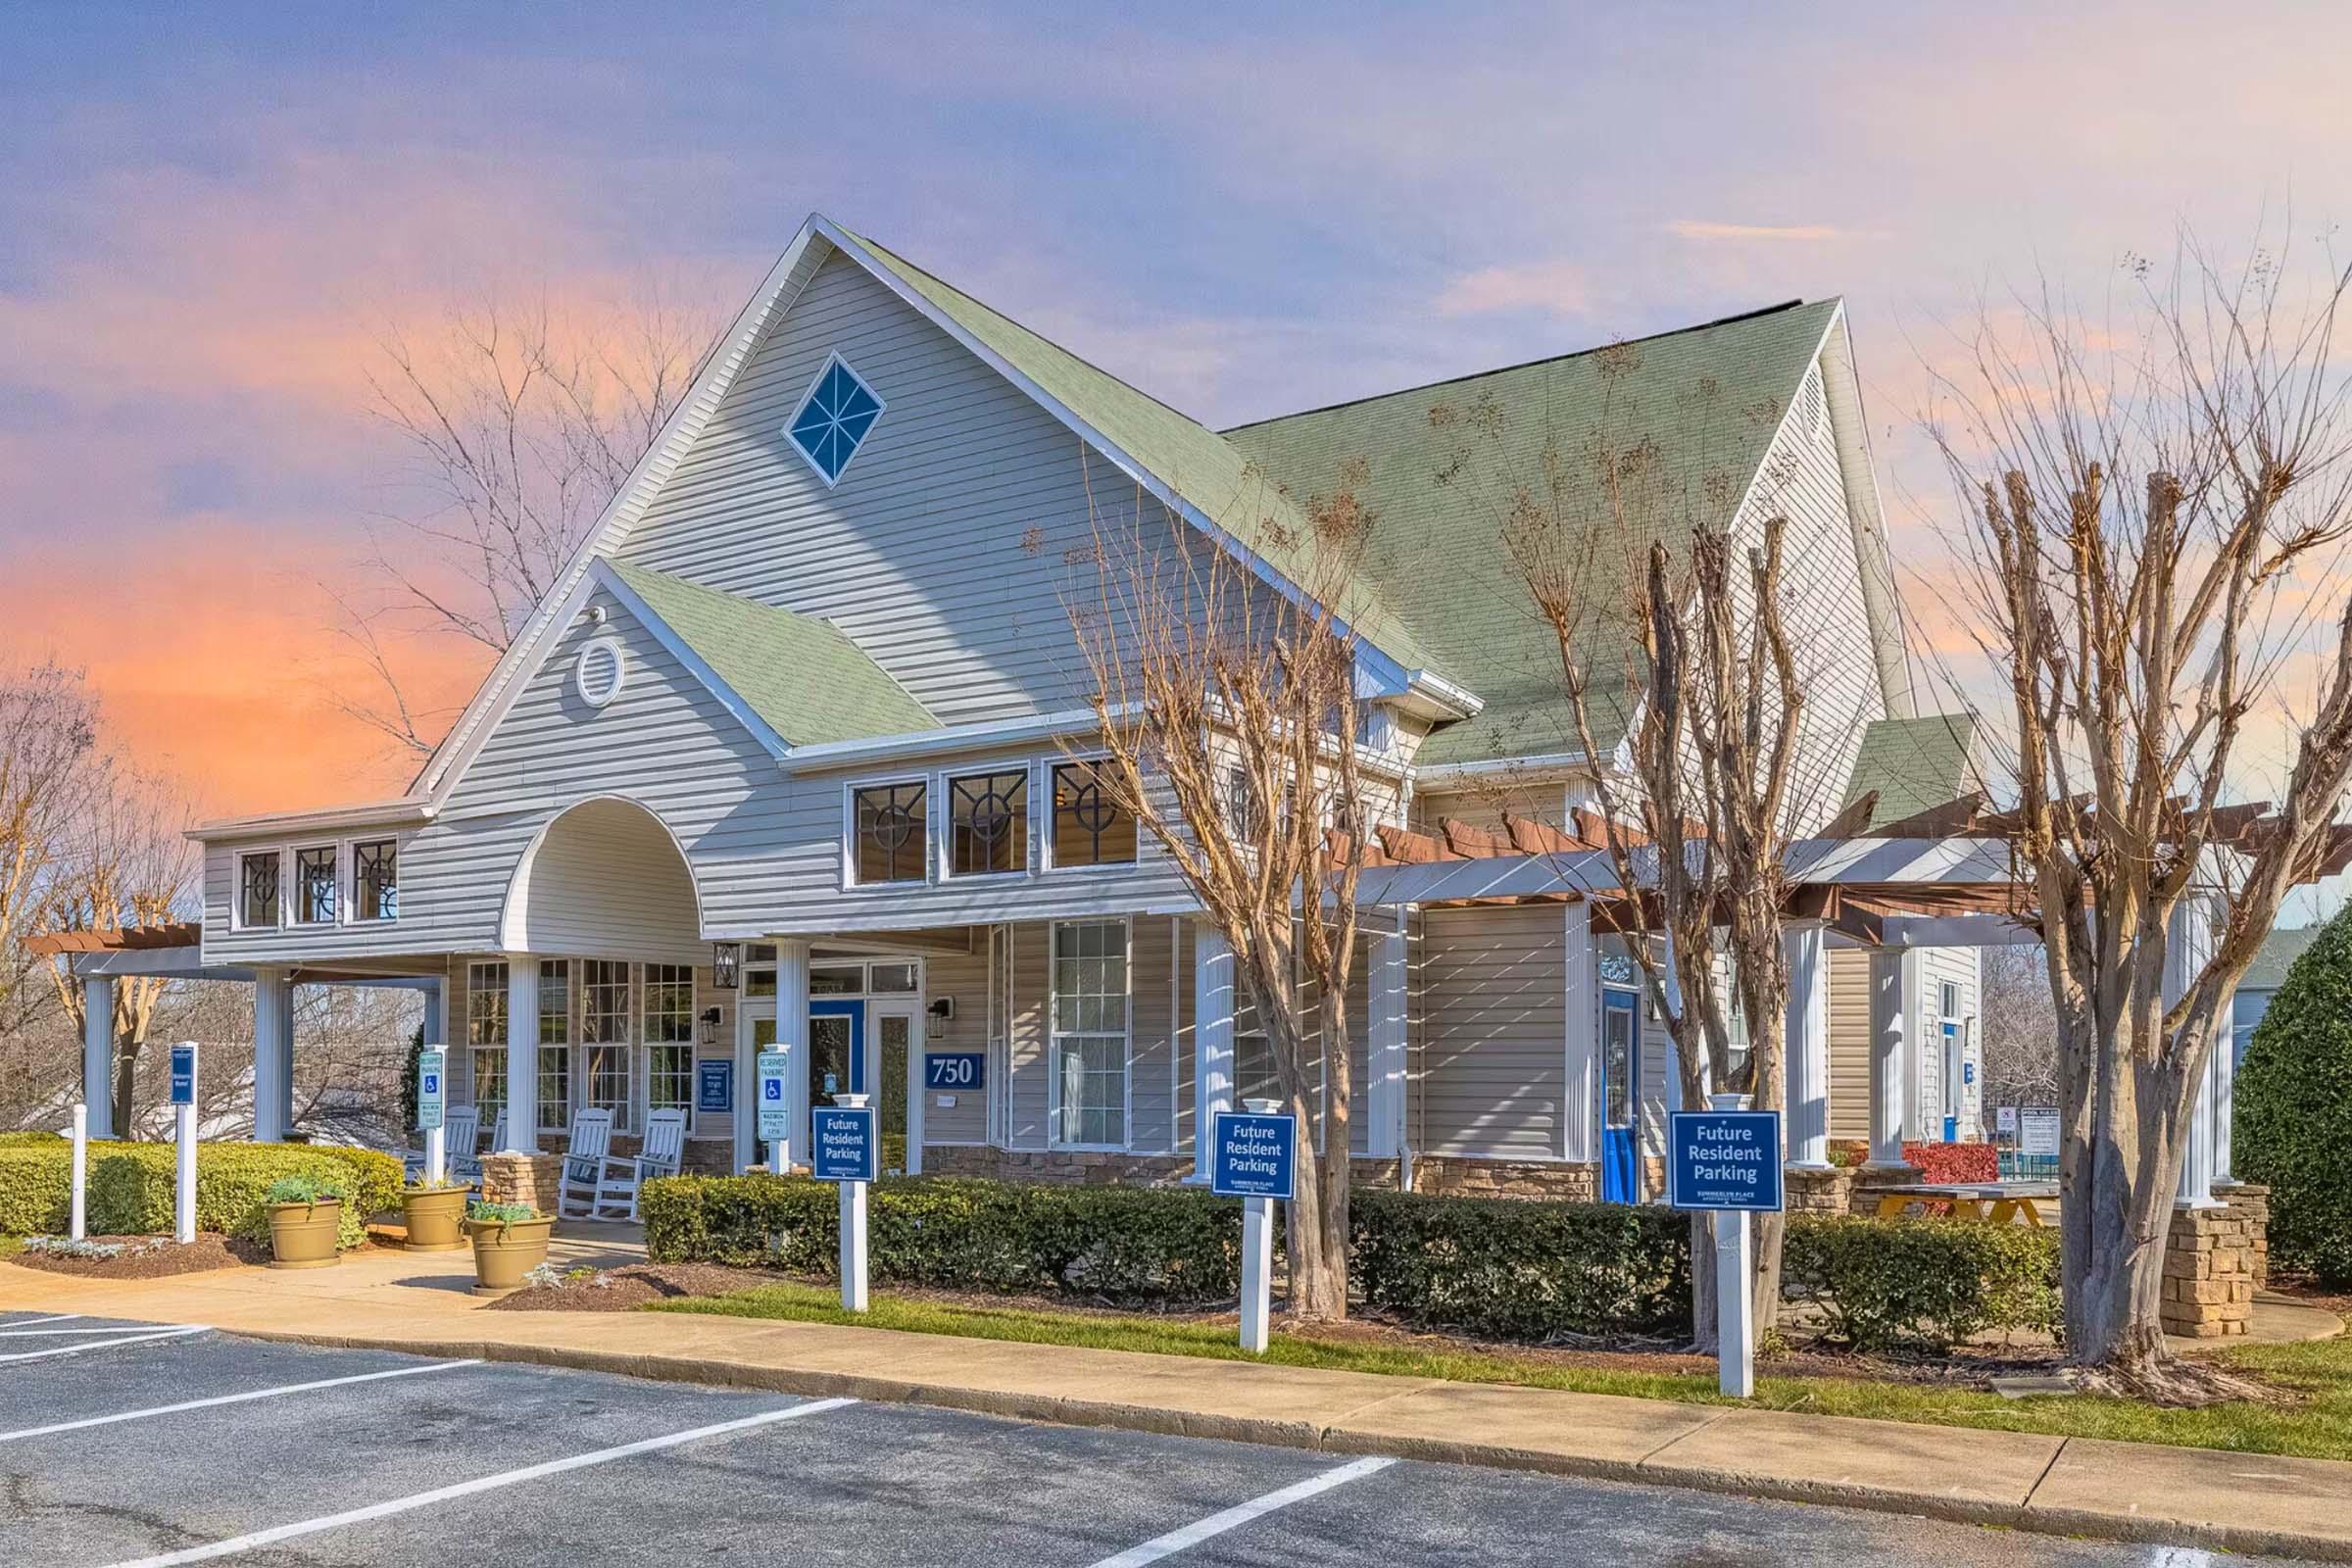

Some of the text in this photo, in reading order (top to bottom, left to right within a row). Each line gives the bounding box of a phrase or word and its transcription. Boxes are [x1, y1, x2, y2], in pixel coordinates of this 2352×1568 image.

[760, 1057, 786, 1066] RESERVED
[761, 1068, 785, 1077] PARKING
[932, 1057, 973, 1083] 750
[827, 1117, 859, 1130] Future
[822, 1132, 864, 1146] Resident
[1233, 1124, 1276, 1139] Future
[1696, 1125, 1753, 1142] Future
[825, 1147, 862, 1162] Parking
[1226, 1141, 1282, 1156] Resident
[1689, 1145, 1763, 1161] Resident
[1229, 1157, 1278, 1176] Parking
[1694, 1164, 1757, 1185] Parking
